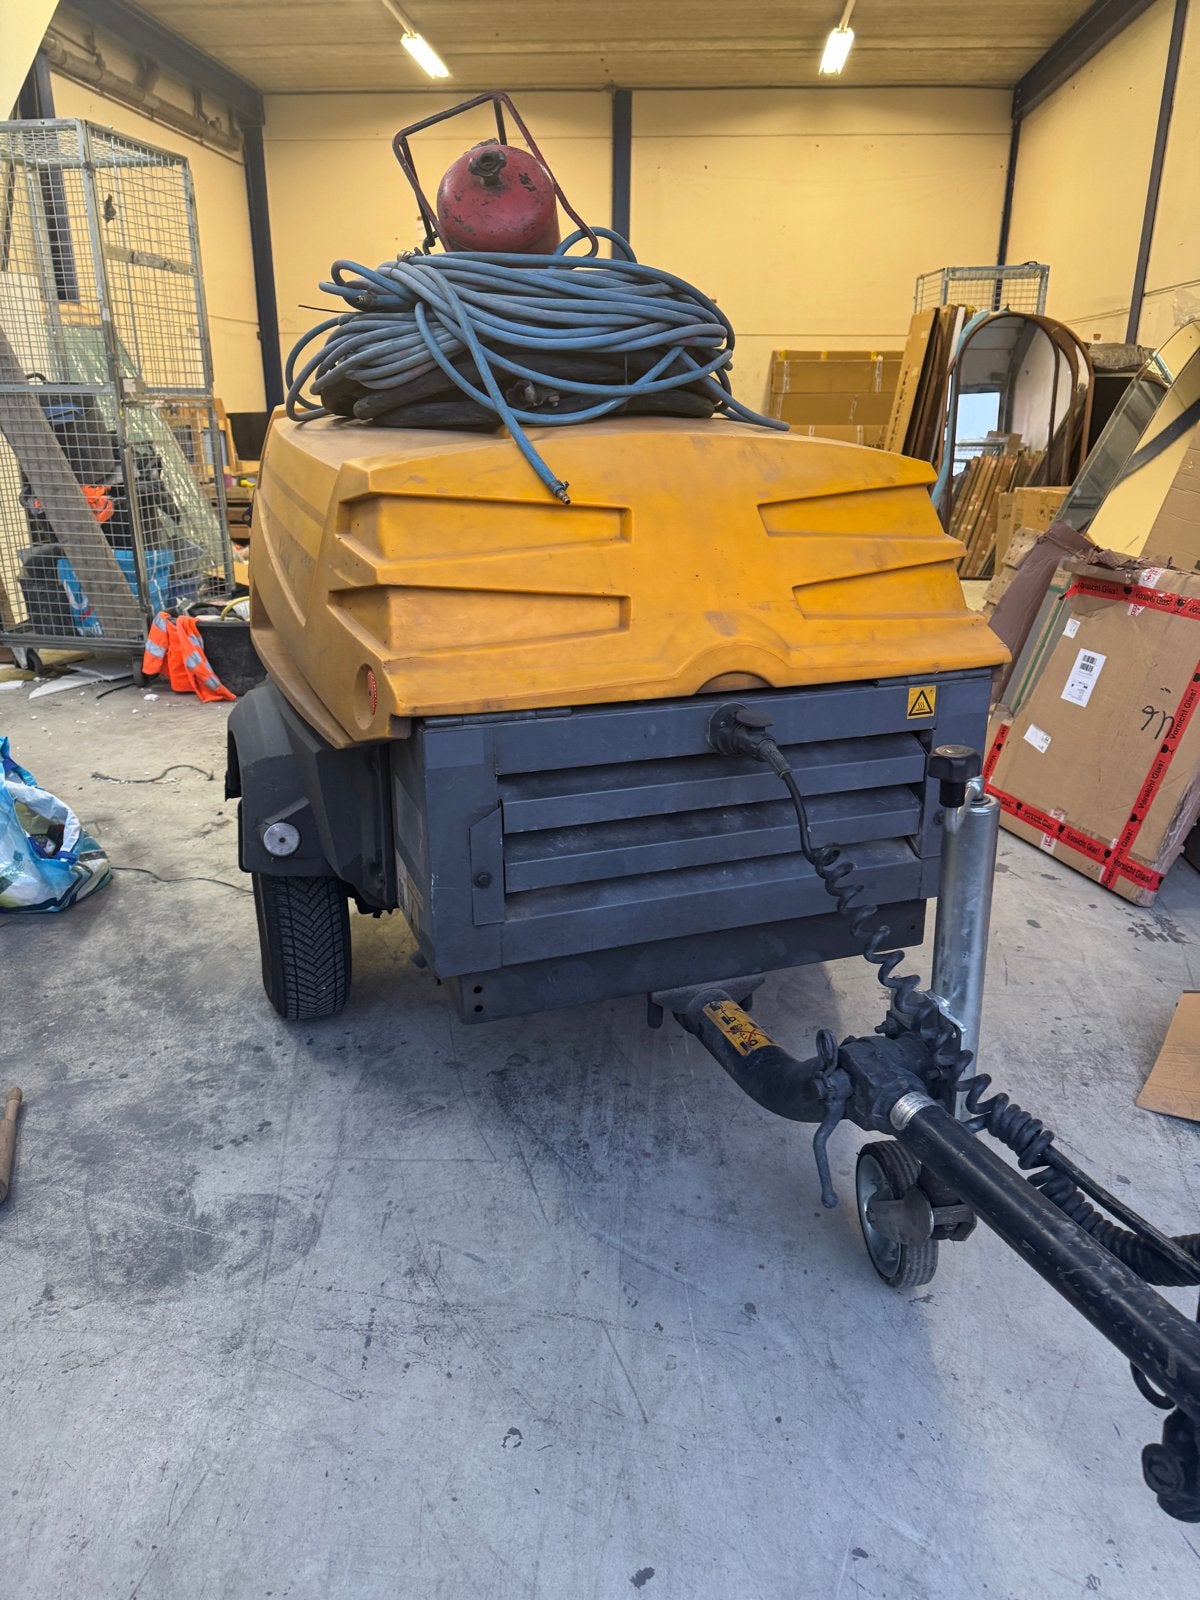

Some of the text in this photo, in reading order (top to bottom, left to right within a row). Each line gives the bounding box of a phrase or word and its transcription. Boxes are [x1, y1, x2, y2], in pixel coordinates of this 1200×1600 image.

[1169, 689, 1197, 740] Vorsicht Glas!
[1138, 760, 1166, 810] Vorsicht Glas!
[1067, 831, 1087, 847] Vorsicht
[1086, 841, 1102, 855] Glas!
[1121, 828, 1133, 848] Glas!
[1134, 869, 1153, 885] Glas!
